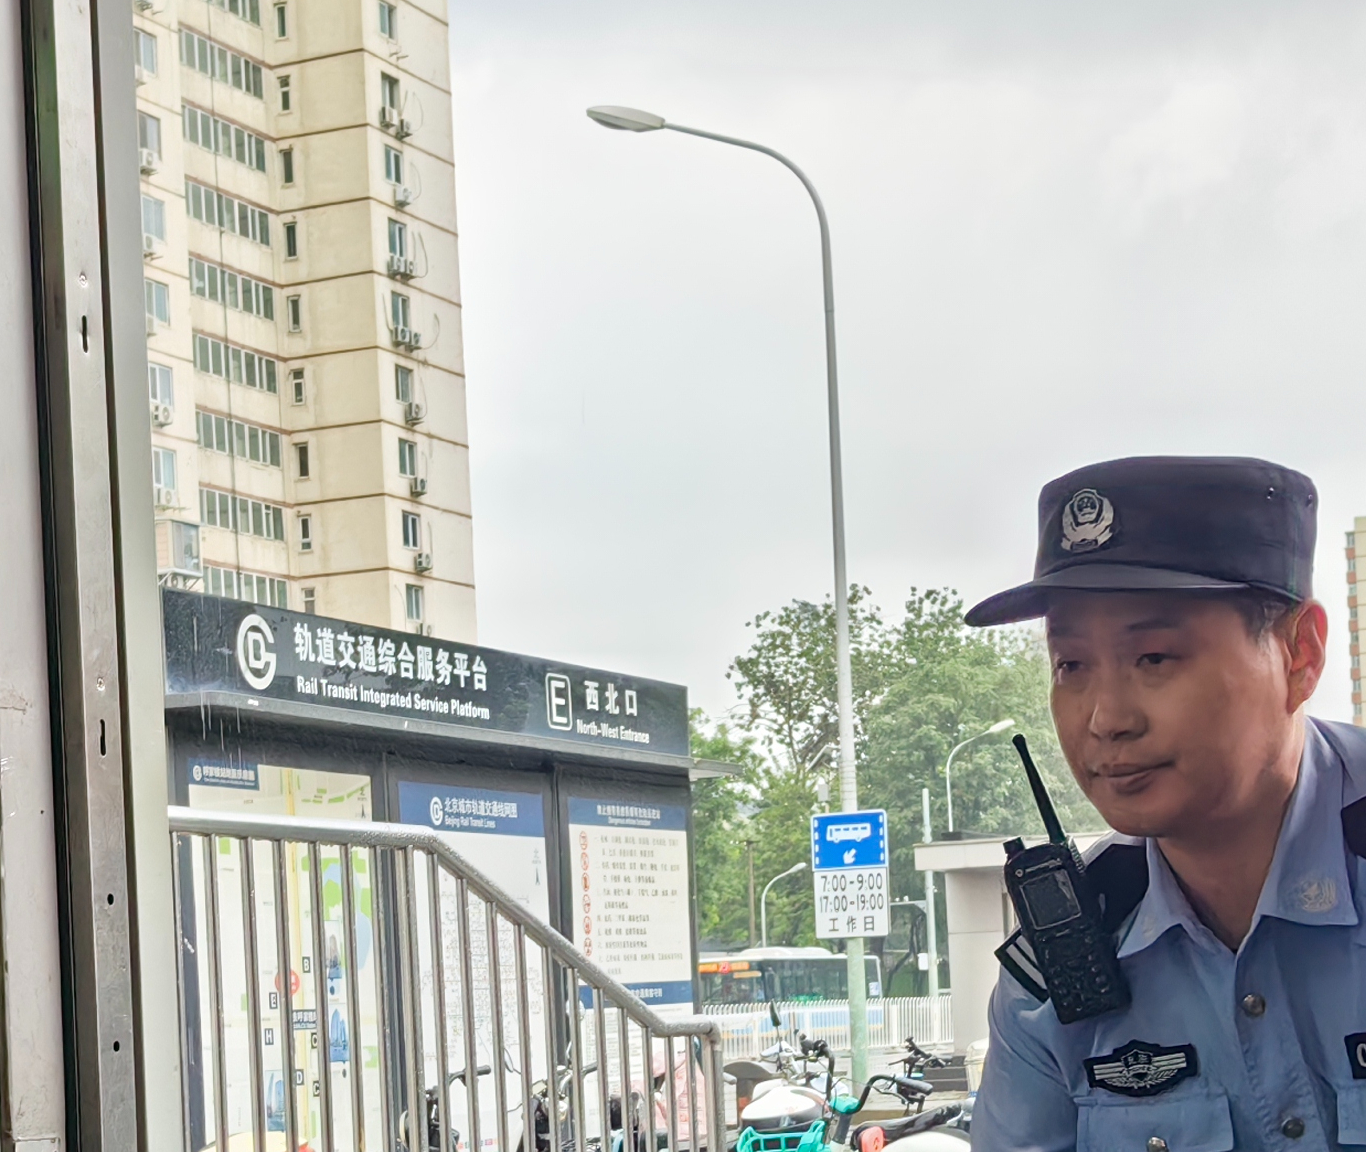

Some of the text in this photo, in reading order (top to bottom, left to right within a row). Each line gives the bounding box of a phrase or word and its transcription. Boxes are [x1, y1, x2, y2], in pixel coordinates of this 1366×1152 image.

[293, 621, 488, 692] 轨道交通综合服务平台
[296, 674, 491, 721] Rail Transit Integrated Service Platform
[550, 679, 568, 724] E
[583, 680, 638, 717] 西北口
[576, 718, 650, 744] North-West Entrance
[444, 797, 518, 819] 北京城市轨道交通线网图
[820, 873, 883, 892] 7:00-9:00
[819, 893, 885, 914] 17:00-19:00
[828, 915, 875, 933] 工作日
